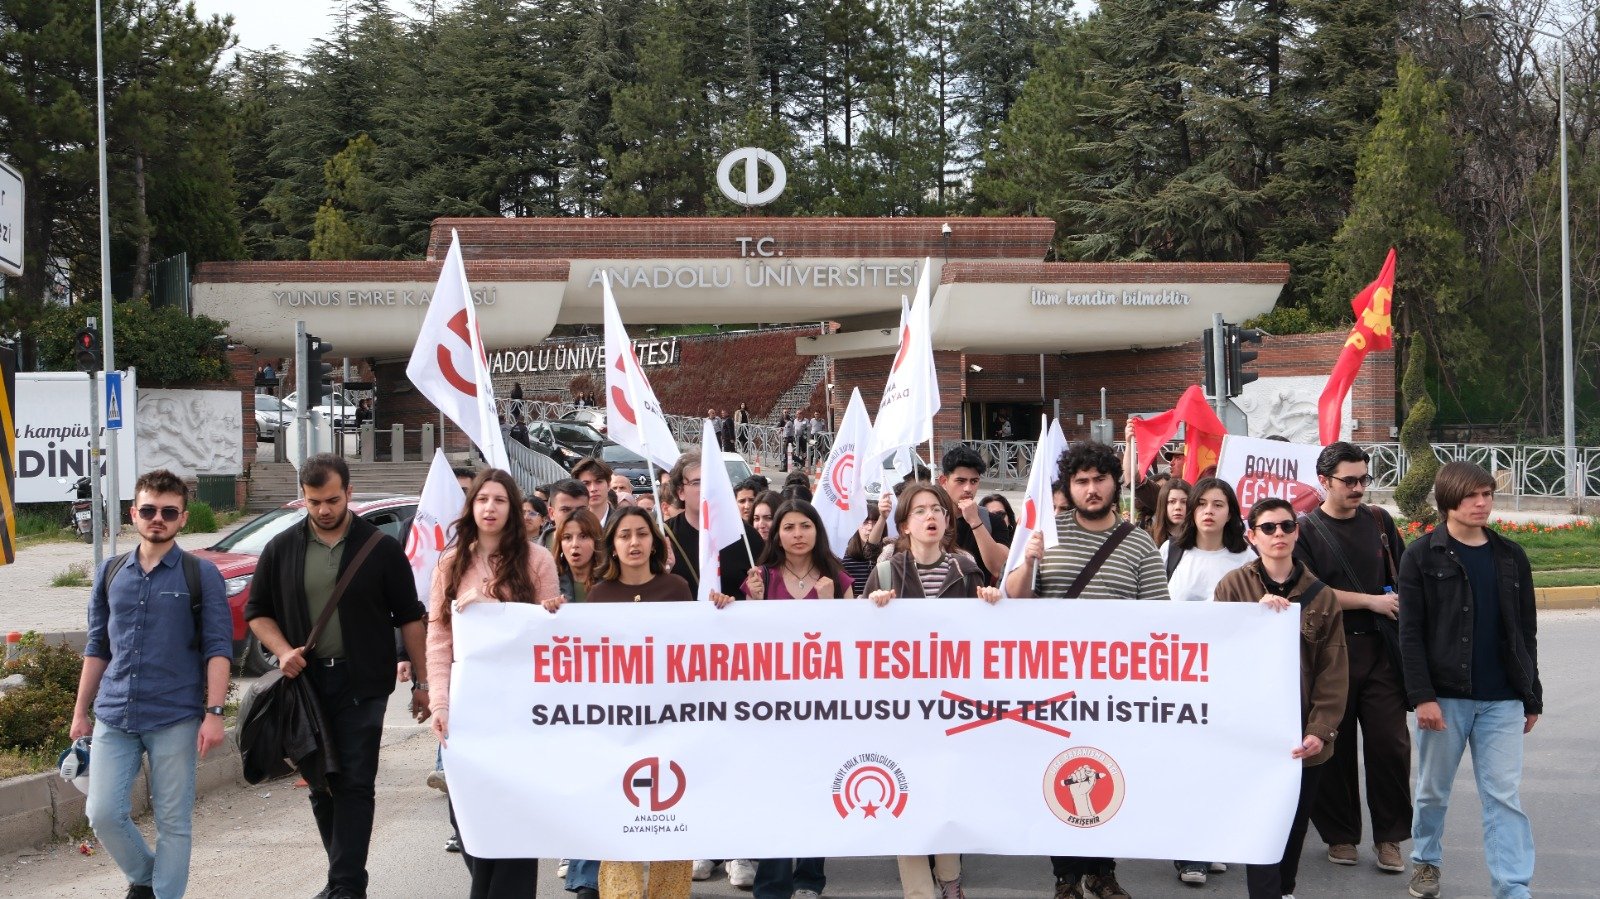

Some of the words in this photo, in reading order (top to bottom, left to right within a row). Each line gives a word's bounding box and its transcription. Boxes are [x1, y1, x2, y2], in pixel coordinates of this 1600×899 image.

[736, 237, 784, 257] T.C.
[588, 266, 732, 289] ANADOLU
[745, 259, 919, 288] ÜNİVERSİTESİ
[273, 290, 341, 306] YUNUS
[347, 290, 396, 306] EMRE
[403, 286, 498, 306] KASÜ
[1066, 288, 1119, 306] kendin
[1122, 289, 1191, 306] bilmektir
[487, 349, 550, 374] ADOLU
[1246, 455, 1298, 481] BOYUN
[533, 636, 654, 684] EĞİTİMİ
[667, 632, 844, 683] KARANLIĞA
[855, 632, 971, 680] TESLİM
[983, 632, 1209, 683] ETMEYECEĞİZ!
[532, 701, 727, 726] SALDIRILARIN
[734, 699, 910, 721] SORUMLUSU
[917, 700, 1011, 721] YUSUF
[1017, 693, 1100, 722] TEKİN
[1107, 694, 1209, 725] İSTİFA!
[634, 814, 676, 822] ANADOLU
[1067, 815, 1100, 826] ESKİŞEHİR
[623, 825, 672, 834] DAYANIŞMA
[674, 823, 688, 832] AĞI
